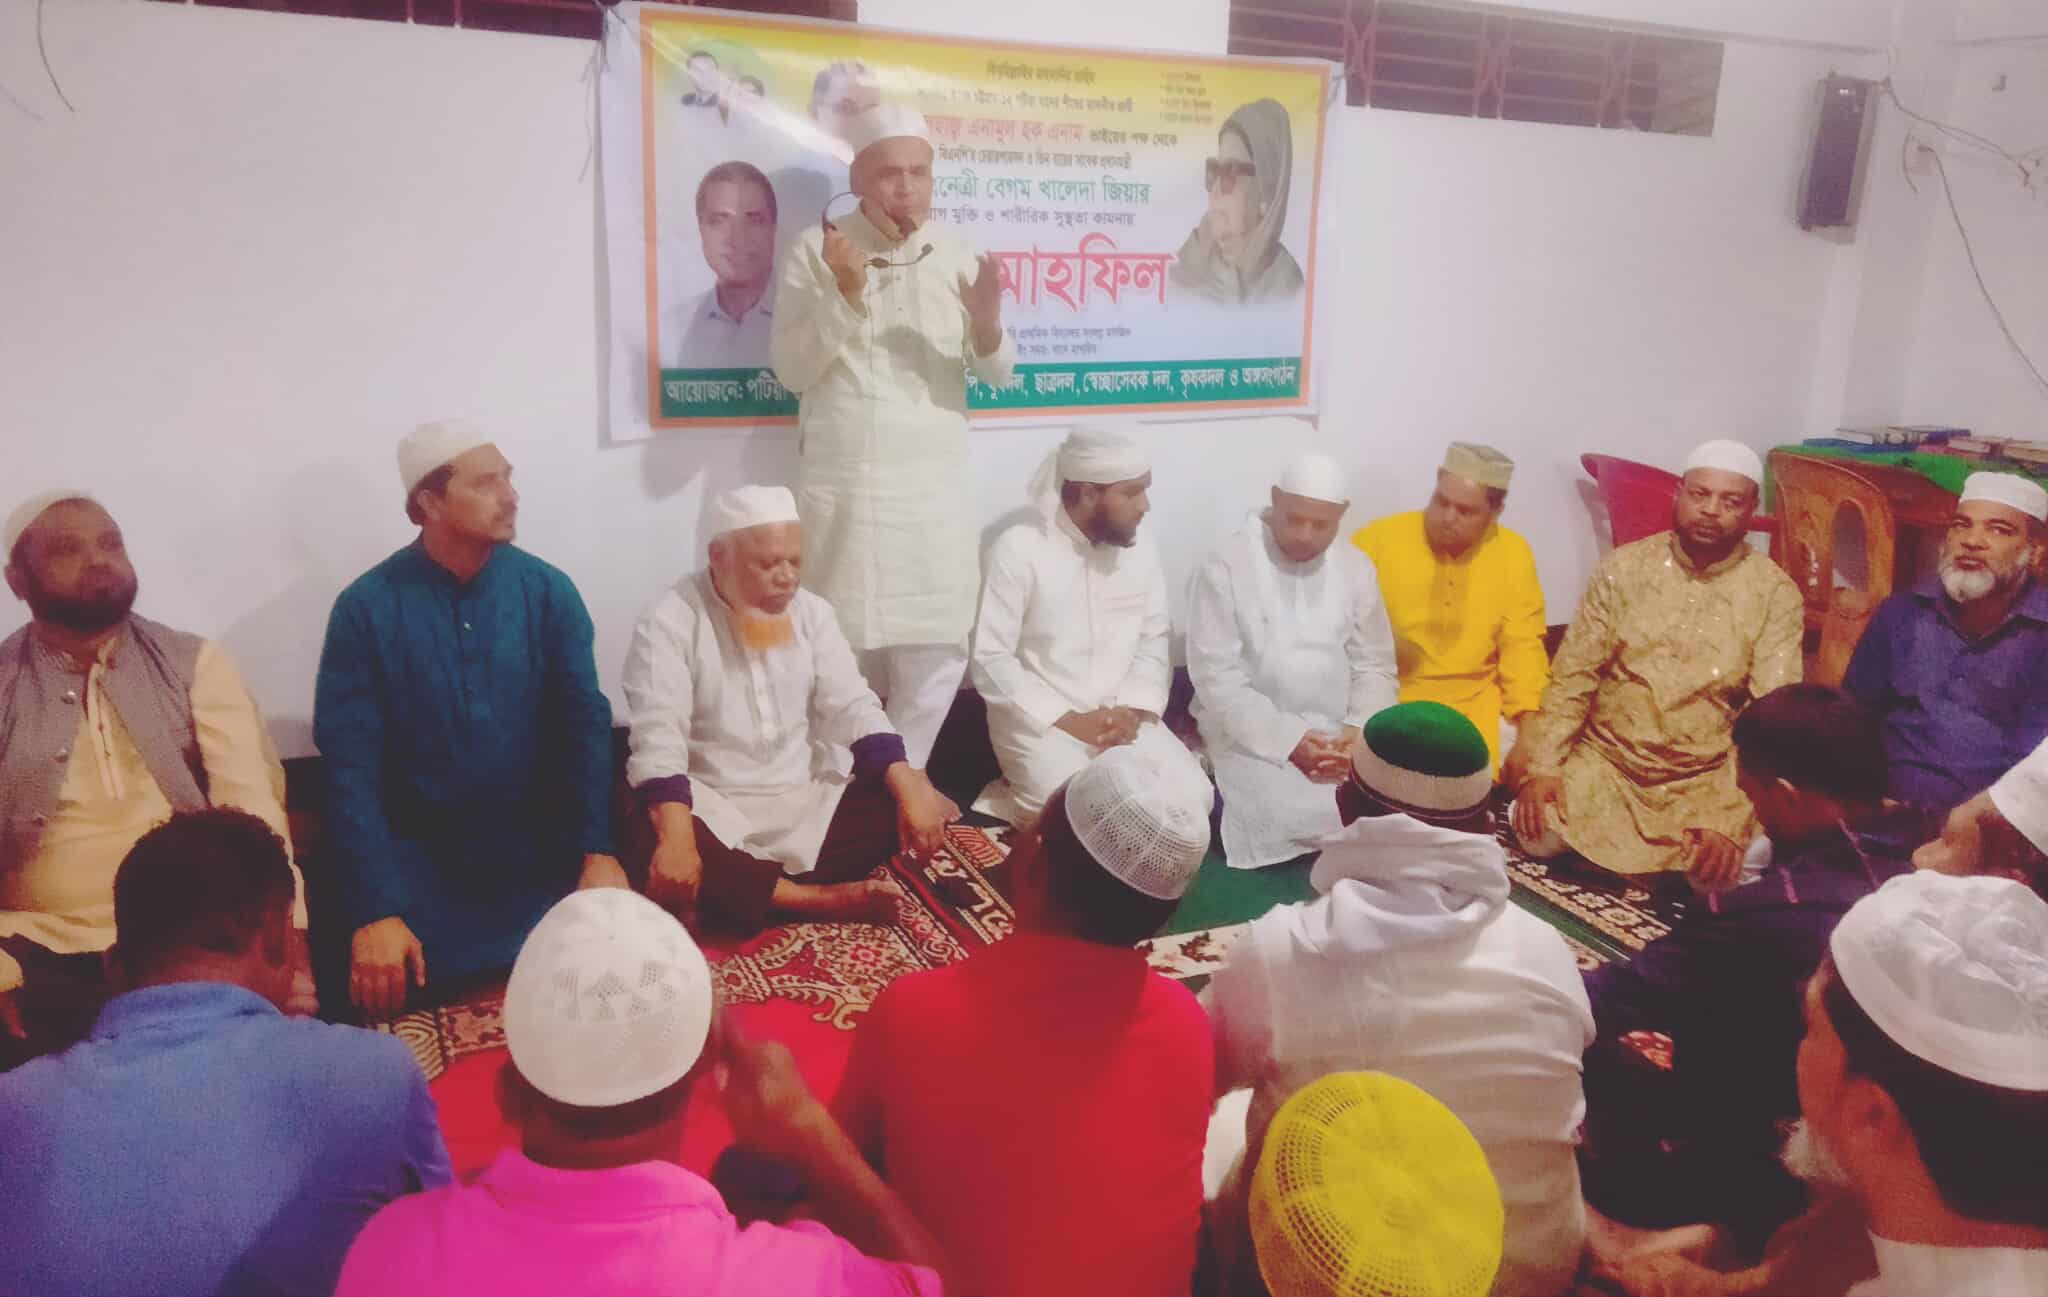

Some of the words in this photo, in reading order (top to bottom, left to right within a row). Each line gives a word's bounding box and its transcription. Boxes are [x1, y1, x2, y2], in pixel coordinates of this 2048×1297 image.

[933, 169, 978, 199] নেত্রী
[986, 176, 1032, 199] বেগম
[1039, 178, 1096, 203] খালেদা
[1103, 175, 1152, 204] জিয়ার
